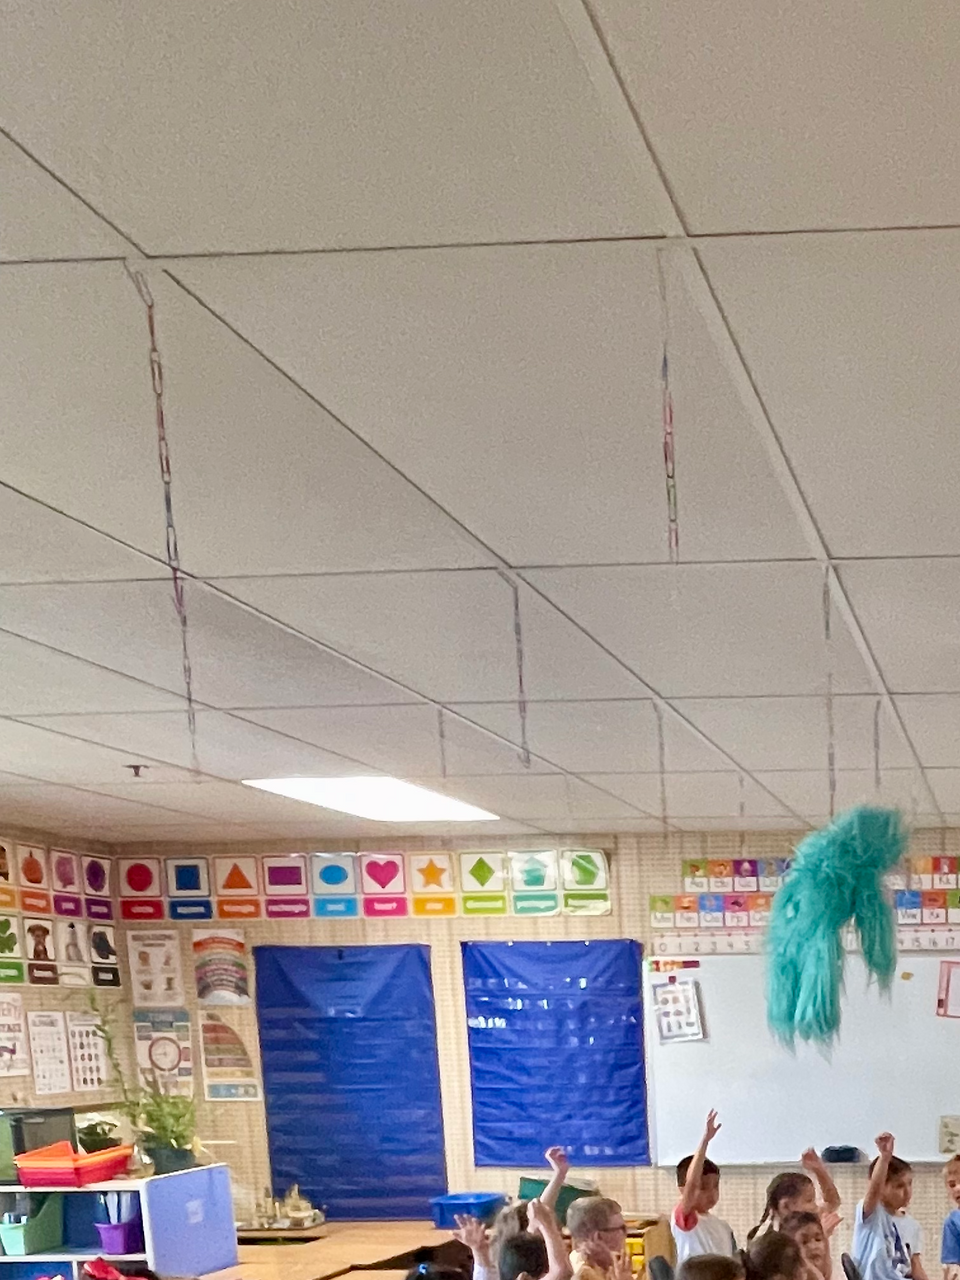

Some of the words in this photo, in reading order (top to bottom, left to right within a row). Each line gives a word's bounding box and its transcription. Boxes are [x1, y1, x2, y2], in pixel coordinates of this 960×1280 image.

[660, 942, 667, 952] 0
[928, 937, 938, 948] 16
[945, 937, 955, 946] 17
